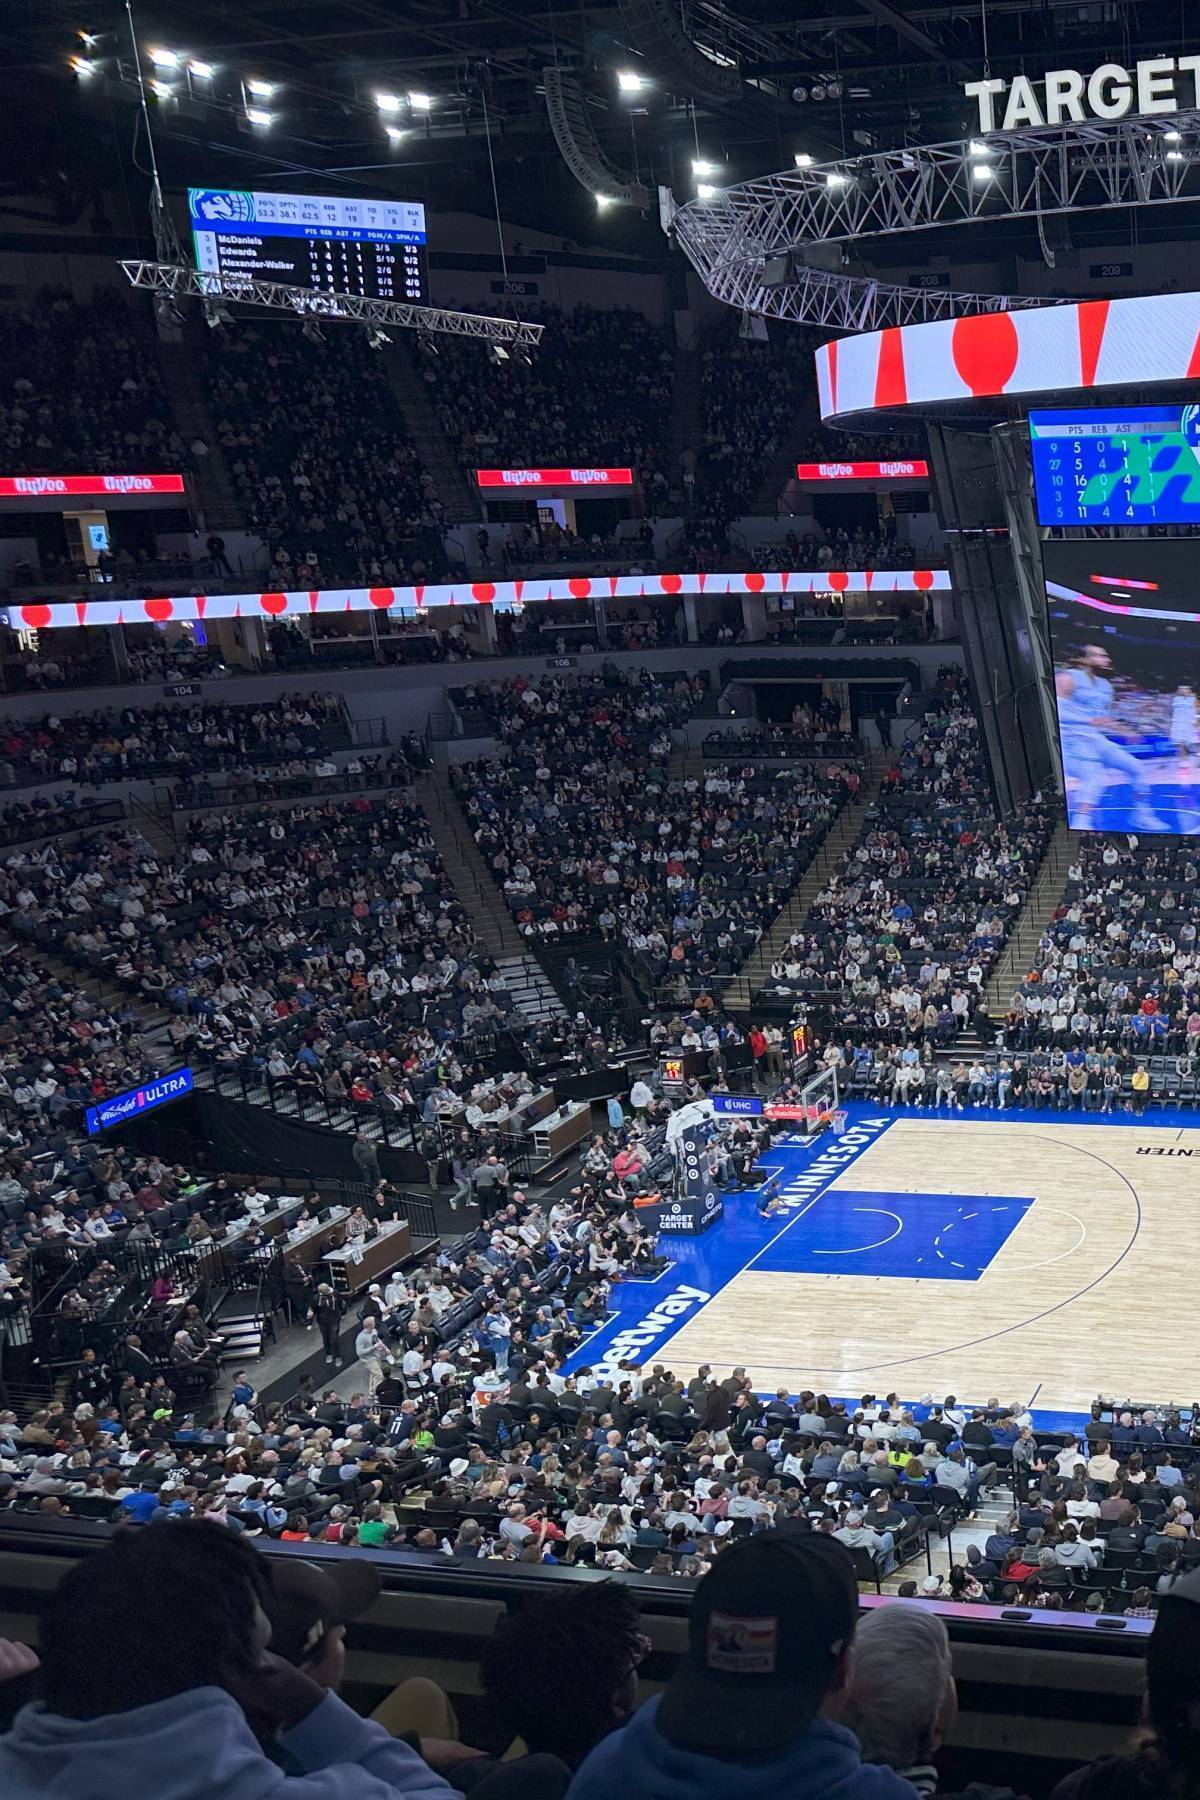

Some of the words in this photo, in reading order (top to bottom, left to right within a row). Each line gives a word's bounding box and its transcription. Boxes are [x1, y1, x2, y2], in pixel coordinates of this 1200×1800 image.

[302, 212, 319, 220] 62.5
[327, 213, 336, 221] 12
[218, 235, 262, 245] McDaniels
[220, 247, 257, 257] Edwards
[325, 252, 332, 260] 4
[341, 253, 347, 261] 4
[404, 256, 418, 265] 0/2
[221, 258, 294, 270] Alexander-Walker
[1102, 265, 1121, 276] 209
[920, 275, 939, 287] 208
[378, 288, 394, 296] 2/2
[406, 289, 420, 298] 0/0
[1068, 426, 1084, 435] PTS
[1091, 425, 1107, 434] REB
[1115, 424, 1132, 433] AST
[1050, 443, 1057, 454] 9
[1074, 442, 1081, 453] 5
[1097, 441, 1105, 452] 0
[1122, 440, 1126, 452] 1
[1049, 459, 1061, 470] 27
[1075, 458, 1082, 470] 5
[1099, 458, 1106, 469] 4
[1123, 457, 1128, 469] 1
[1052, 476, 1063, 486] 10
[1074, 475, 1087, 486] 16
[1100, 474, 1107, 486] 0
[1124, 473, 1131, 485] 4
[1055, 491, 1062, 501] 3
[1077, 491, 1084, 502] 7
[1102, 491, 1107, 501] 1
[1126, 489, 1130, 501] 1
[1057, 508, 1063, 518] 5
[1077, 507, 1087, 518] 11
[1103, 506, 1110, 517] 4
[1126, 506, 1134, 517] 4
[1151, 505, 1156, 516] 1
[554, 659, 570, 667] 106
[173, 686, 192, 695] 104
[146, 1076, 188, 1102] ULTRA
[733, 1101, 751, 1110] UHC
[659, 1214, 693, 1222] TARGET
[659, 1221, 694, 1229] CENTER
[390, 1421, 402, 1434] 11
